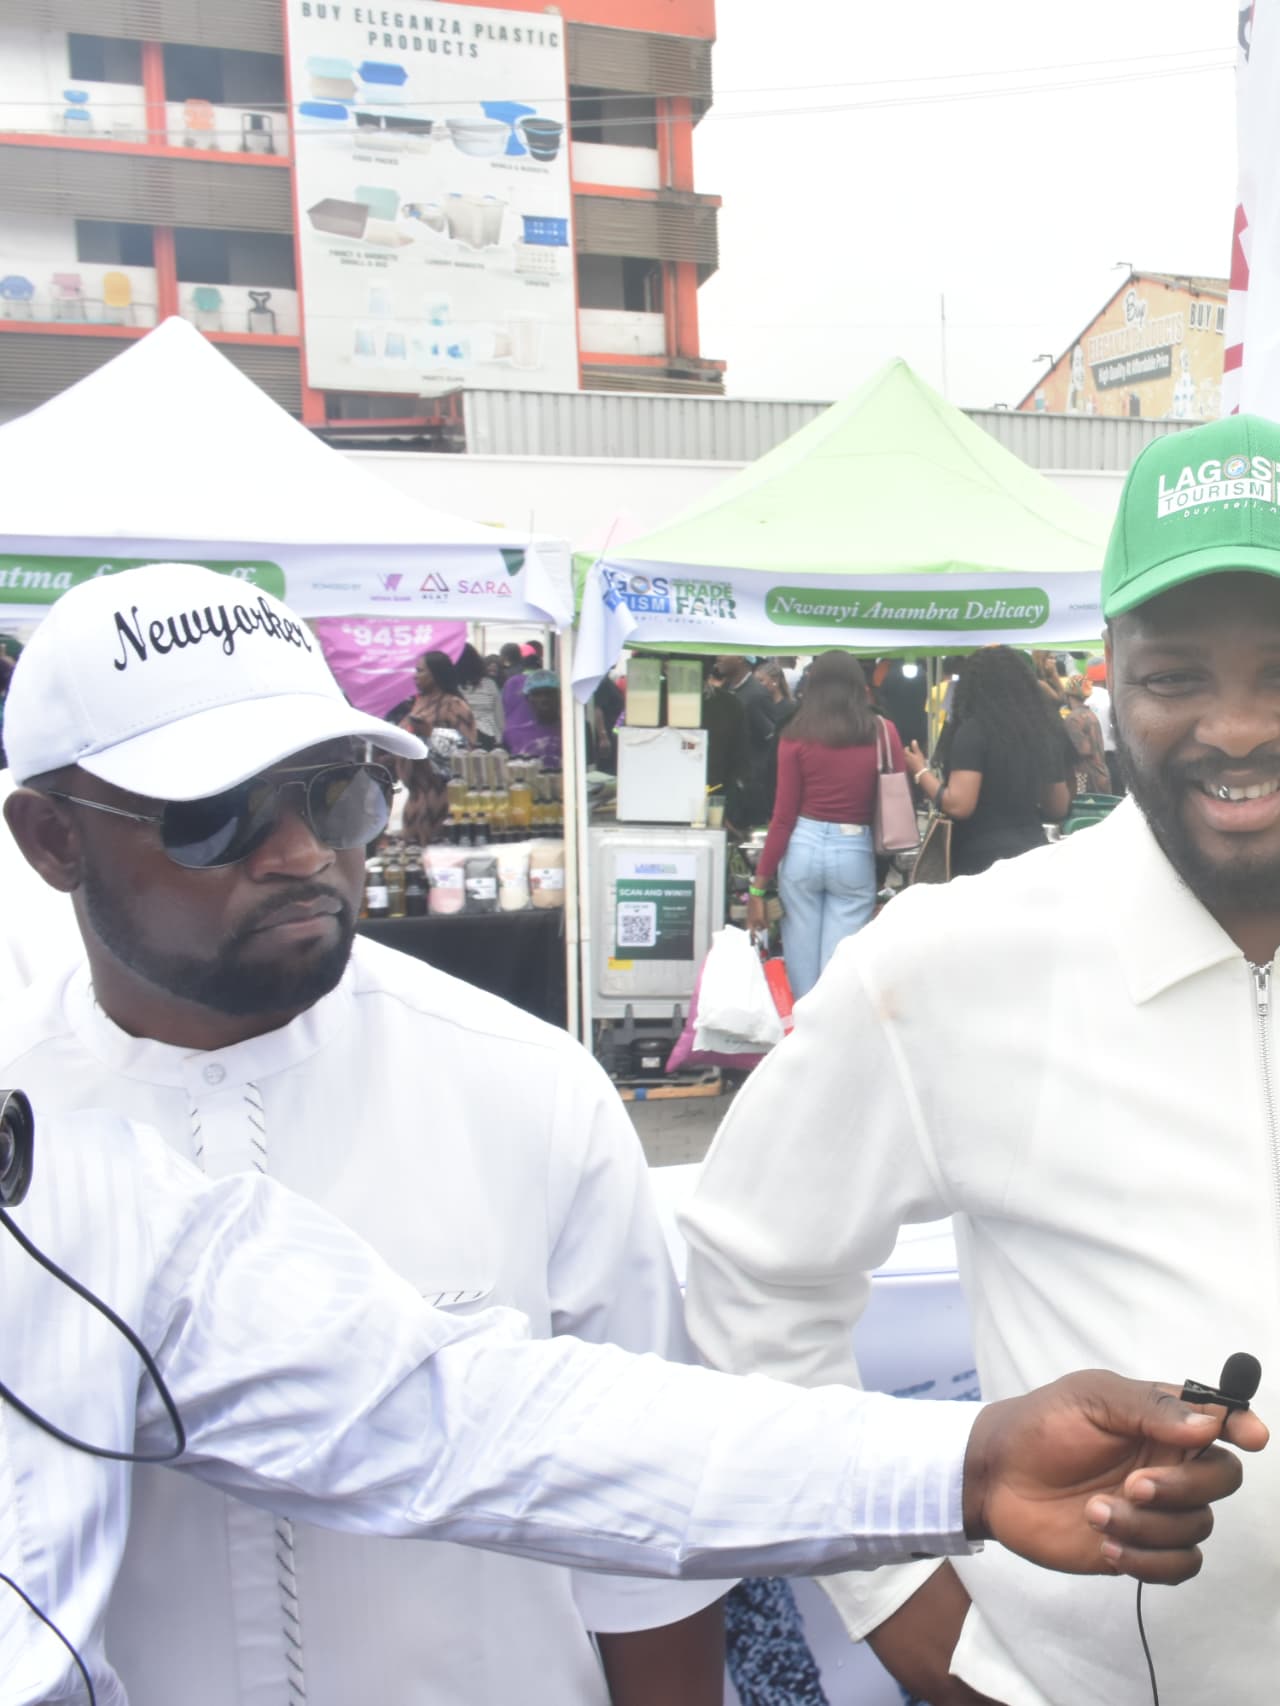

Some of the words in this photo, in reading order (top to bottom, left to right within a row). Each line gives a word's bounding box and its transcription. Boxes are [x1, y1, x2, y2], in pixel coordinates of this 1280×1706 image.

[302, 2, 341, 21] BUY
[355, 8, 461, 35] ELEGANZA
[475, 22, 559, 48] PLASTIC
[368, 31, 478, 59] PRODUCTS
[1190, 303, 1211, 328] BUY
[1159, 455, 1272, 496] LAGOS
[1166, 482, 1265, 511] TOURISM
[673, 582, 733, 600] TRADE
[772, 596, 859, 623] Nwanyi
[863, 600, 958, 622] Anambra
[964, 601, 1046, 624] Delicacy
[113, 596, 312, 671] Newyorker
[619, 888, 642, 897] SCAN
[644, 888, 662, 897] AND
